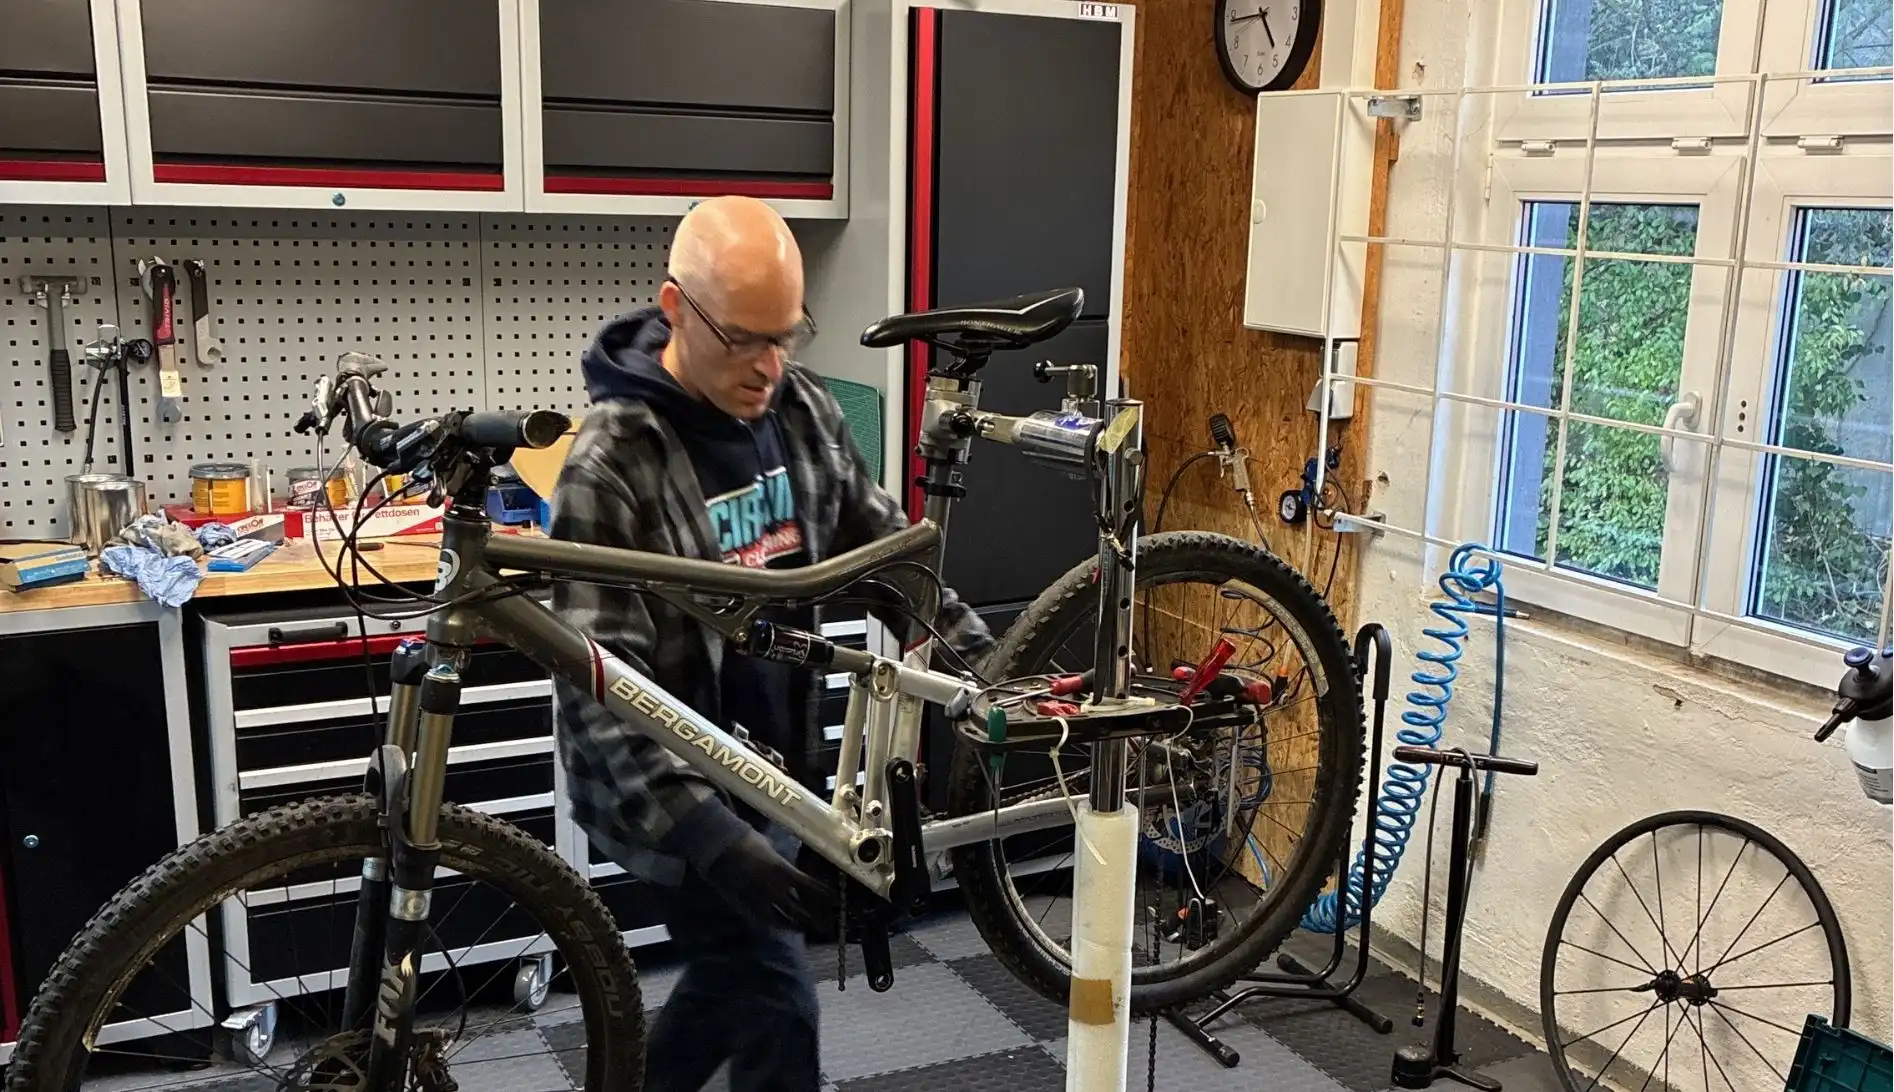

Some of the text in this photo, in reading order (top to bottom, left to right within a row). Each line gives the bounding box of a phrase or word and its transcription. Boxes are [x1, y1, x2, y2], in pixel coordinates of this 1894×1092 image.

[1082, 4, 1116, 17] HBM
[1291, 6, 1298, 21] 3
[1233, 34, 1239, 50] 8
[1284, 34, 1292, 48] 4
[1243, 54, 1249, 68] 7
[1271, 54, 1279, 68] 5
[1257, 63, 1264, 76] 6
[373, 507, 421, 519] ettdosen
[608, 675, 803, 808] BERGAMONT
[373, 945, 405, 1048] FOX
